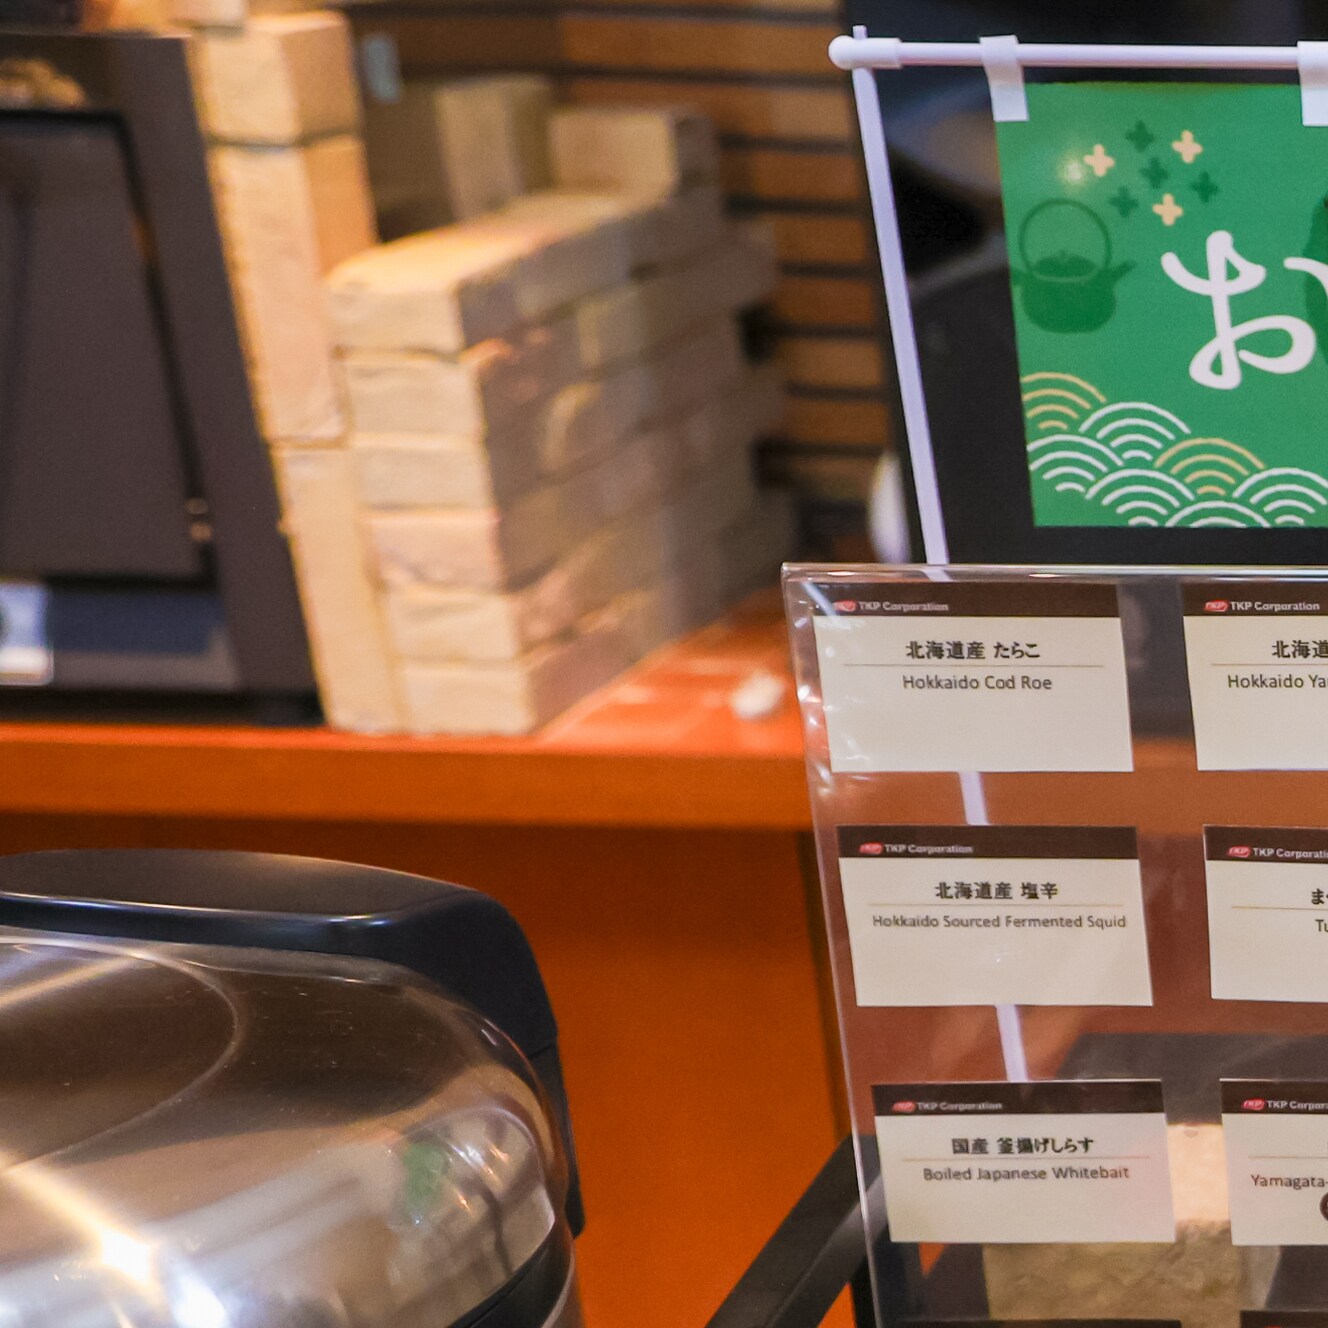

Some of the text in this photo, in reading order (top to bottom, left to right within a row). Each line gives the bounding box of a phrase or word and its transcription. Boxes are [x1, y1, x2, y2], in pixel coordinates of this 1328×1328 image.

[906, 641, 1040, 659] 北海道産 たらこ
[903, 675, 1052, 689] Hokkaido Cod Roe
[1228, 674, 1303, 688] Hokkaido
[936, 882, 1058, 899] 北海道産 塩辛
[873, 916, 1126, 929] Hokkaido Sourced Fermented Squid
[952, 1138, 1093, 1155] 国産 釜揚げしらす
[924, 1167, 1128, 1183] Boiled Japanese Whitebait
